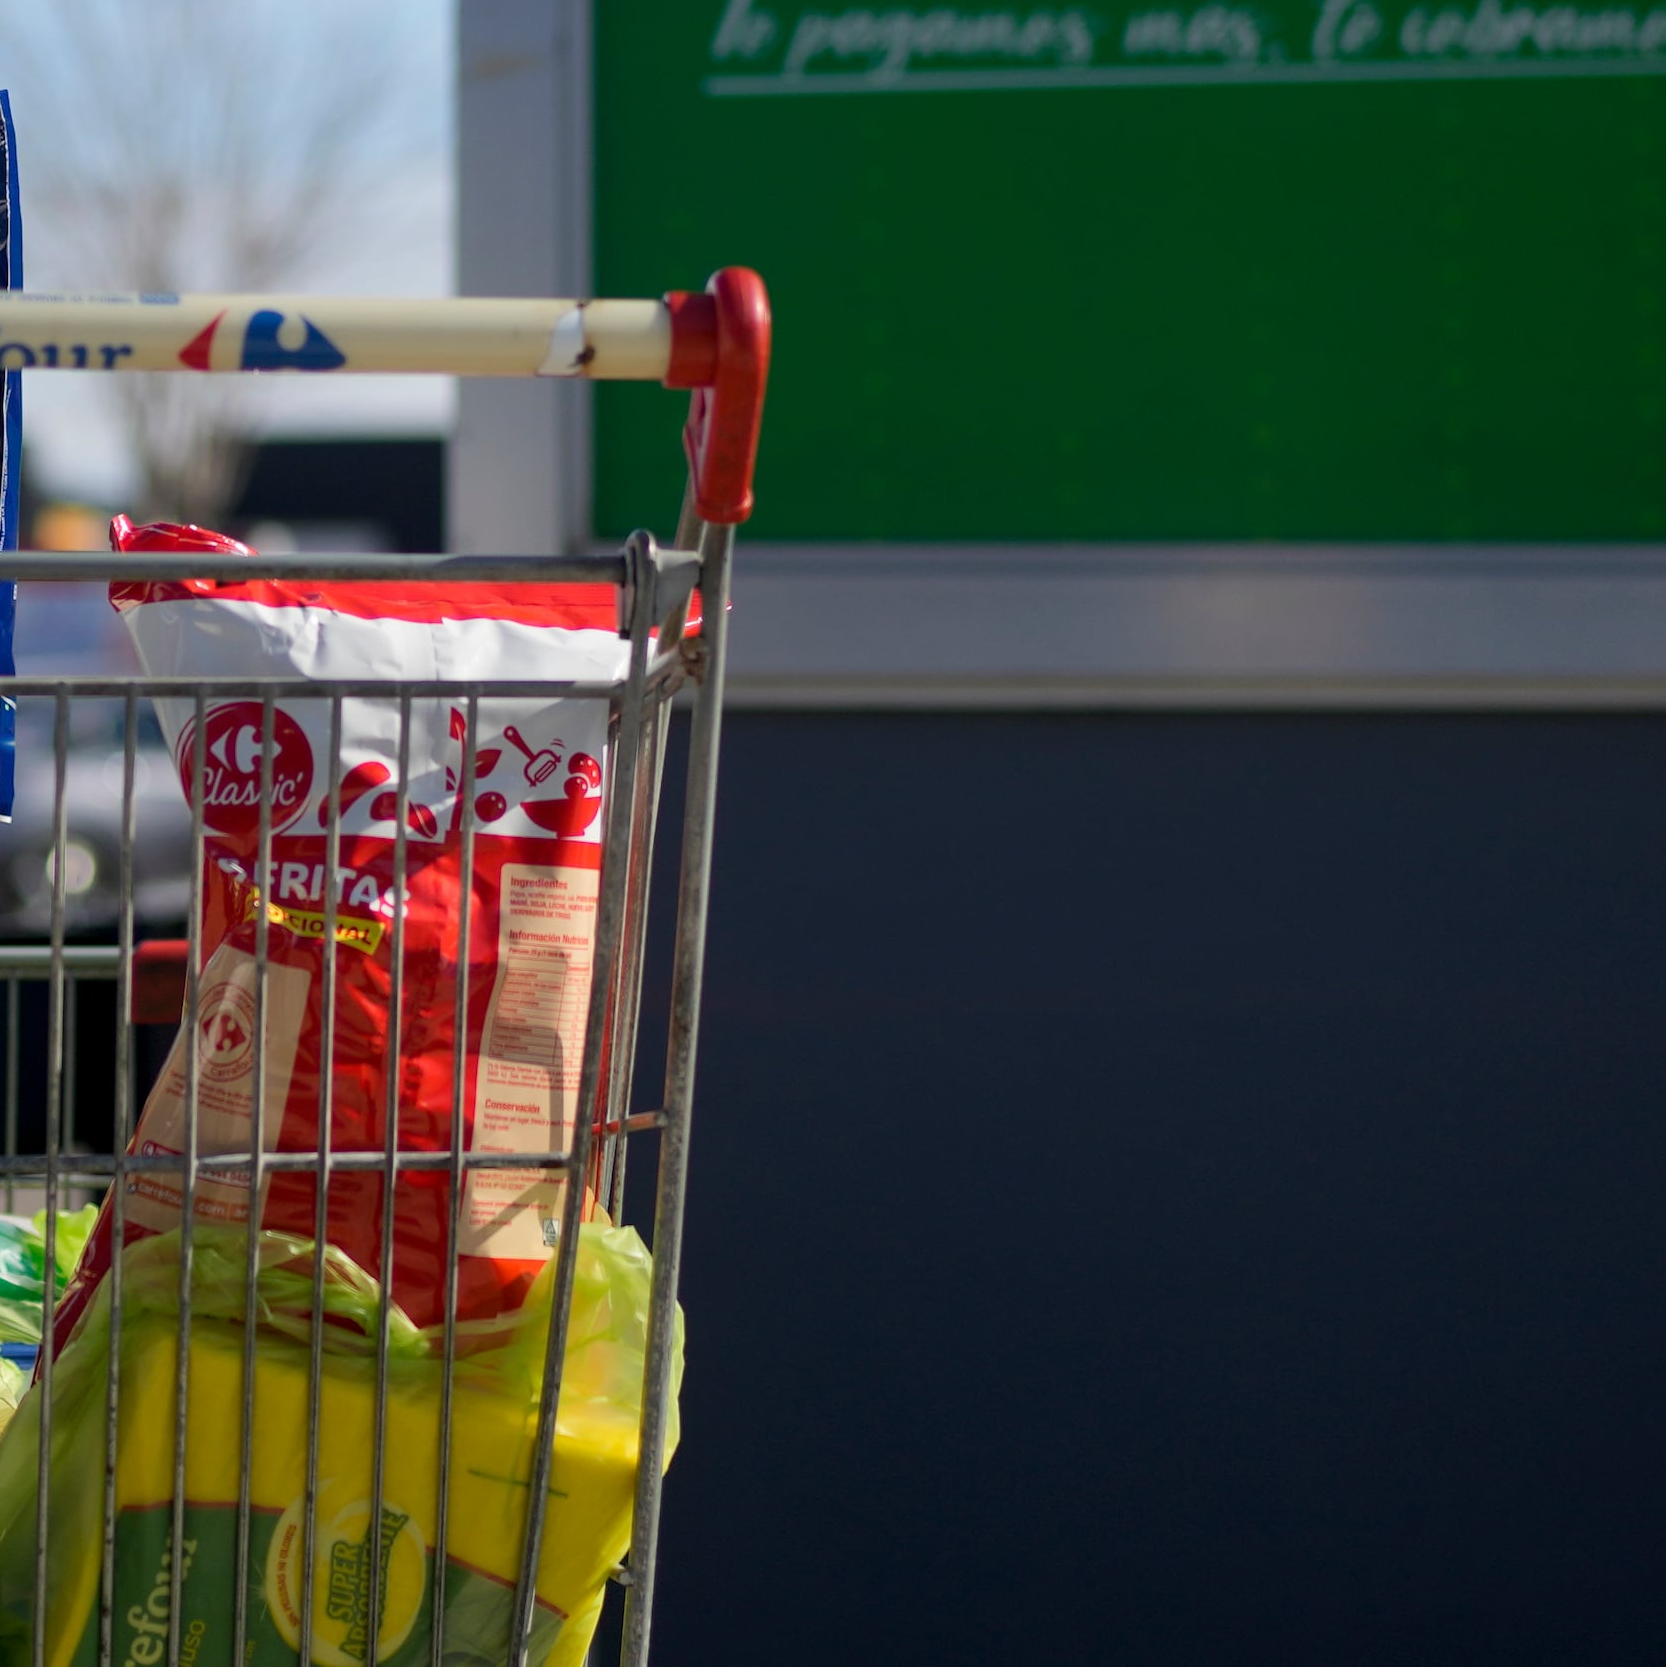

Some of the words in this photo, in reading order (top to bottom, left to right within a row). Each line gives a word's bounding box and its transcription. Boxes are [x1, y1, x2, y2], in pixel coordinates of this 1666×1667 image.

[510, 876, 568, 890] Ingredientes
[509, 929, 561, 943] Información
[485, 1099, 540, 1114] Conservación
[328, 1540, 362, 1622] SUPER
